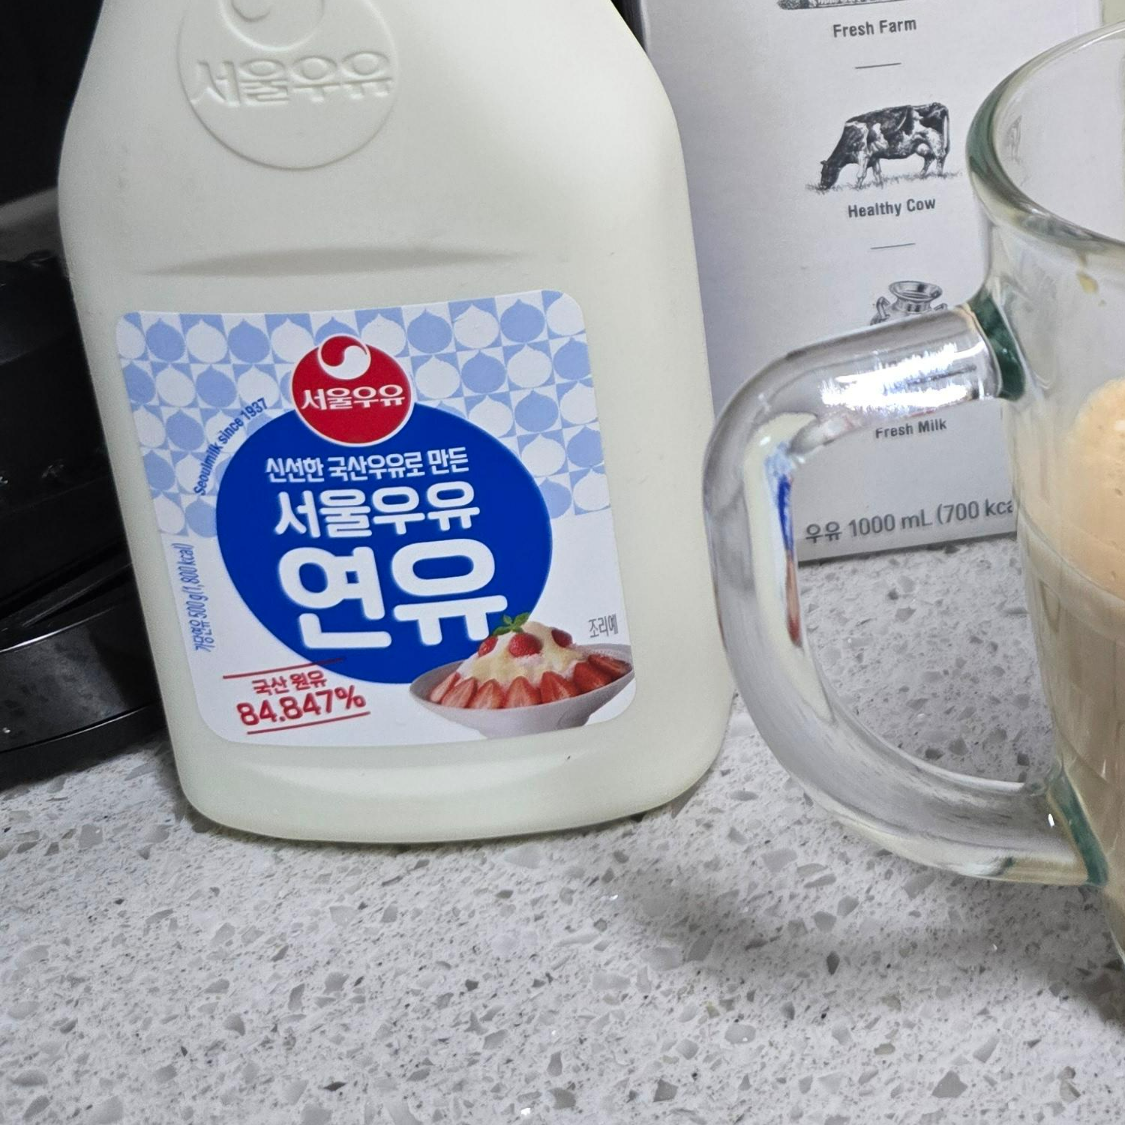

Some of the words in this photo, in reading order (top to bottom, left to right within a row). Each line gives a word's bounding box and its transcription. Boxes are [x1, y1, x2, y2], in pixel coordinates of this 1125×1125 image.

[833, 21, 875, 38] Fresh
[879, 19, 917, 34] Farm
[191, 50, 395, 109] 서울우유
[848, 201, 902, 218] Healthy
[906, 198, 936, 212] Cow
[301, 384, 405, 410] 서울우유
[193, 441, 223, 496] Seoulmilk
[218, 418, 244, 445] since
[241, 397, 268, 420] 1937
[875, 422, 914, 439] Fresh
[918, 418, 947, 433] Milk
[266, 456, 325, 483] 신선한
[327, 451, 425, 482] 국산우유로
[427, 446, 469, 474] 만든
[274, 480, 480, 538] 서울우유
[805, 521, 842, 544] 우유
[848, 514, 896, 537] 1000
[901, 509, 933, 530] mL
[936, 501, 980, 525] (700
[278, 538, 508, 649] 연유
[588, 613, 618, 638] 조리예
[251, 676, 290, 695] 국산
[290, 670, 327, 691] 원유
[236, 685, 366, 725] 84.847%
